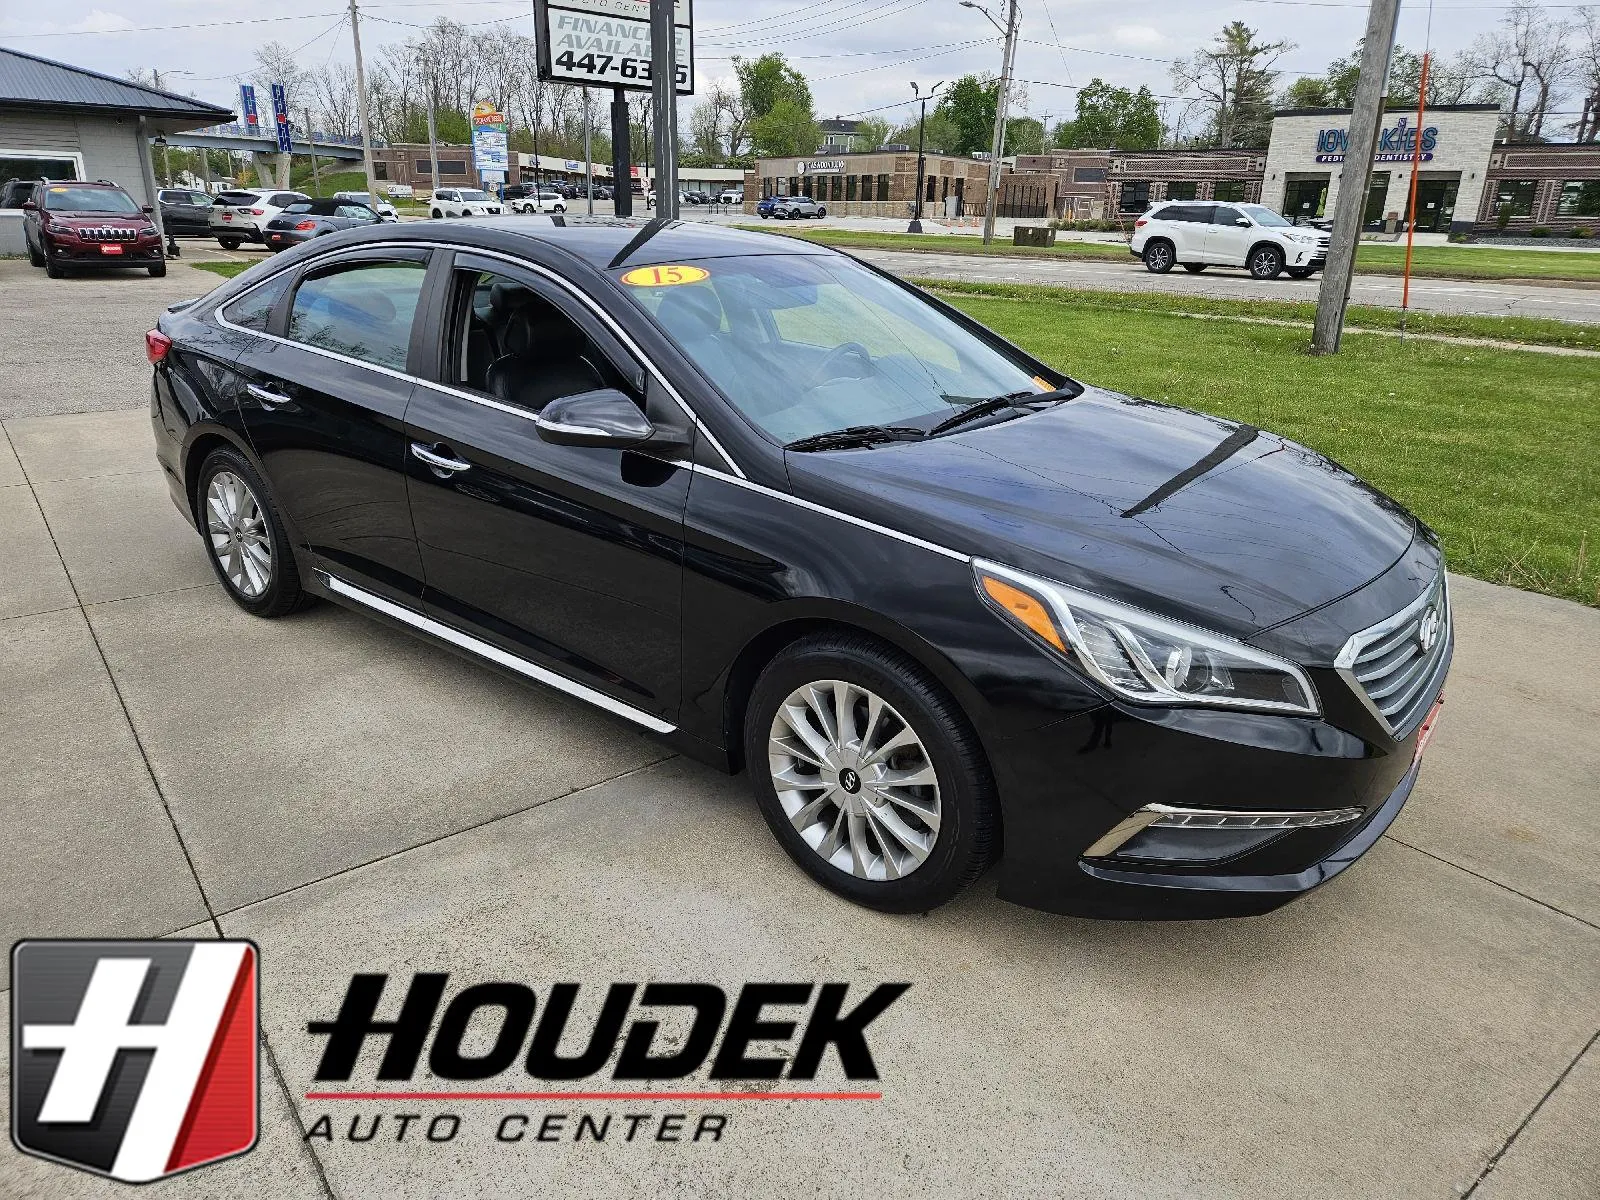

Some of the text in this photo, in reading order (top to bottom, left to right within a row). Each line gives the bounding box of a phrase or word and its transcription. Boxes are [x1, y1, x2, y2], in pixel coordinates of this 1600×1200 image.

[555, 50, 688, 84] 447-635
[1374, 153, 1427, 161] DENTISTY
[652, 267, 682, 285] 15
